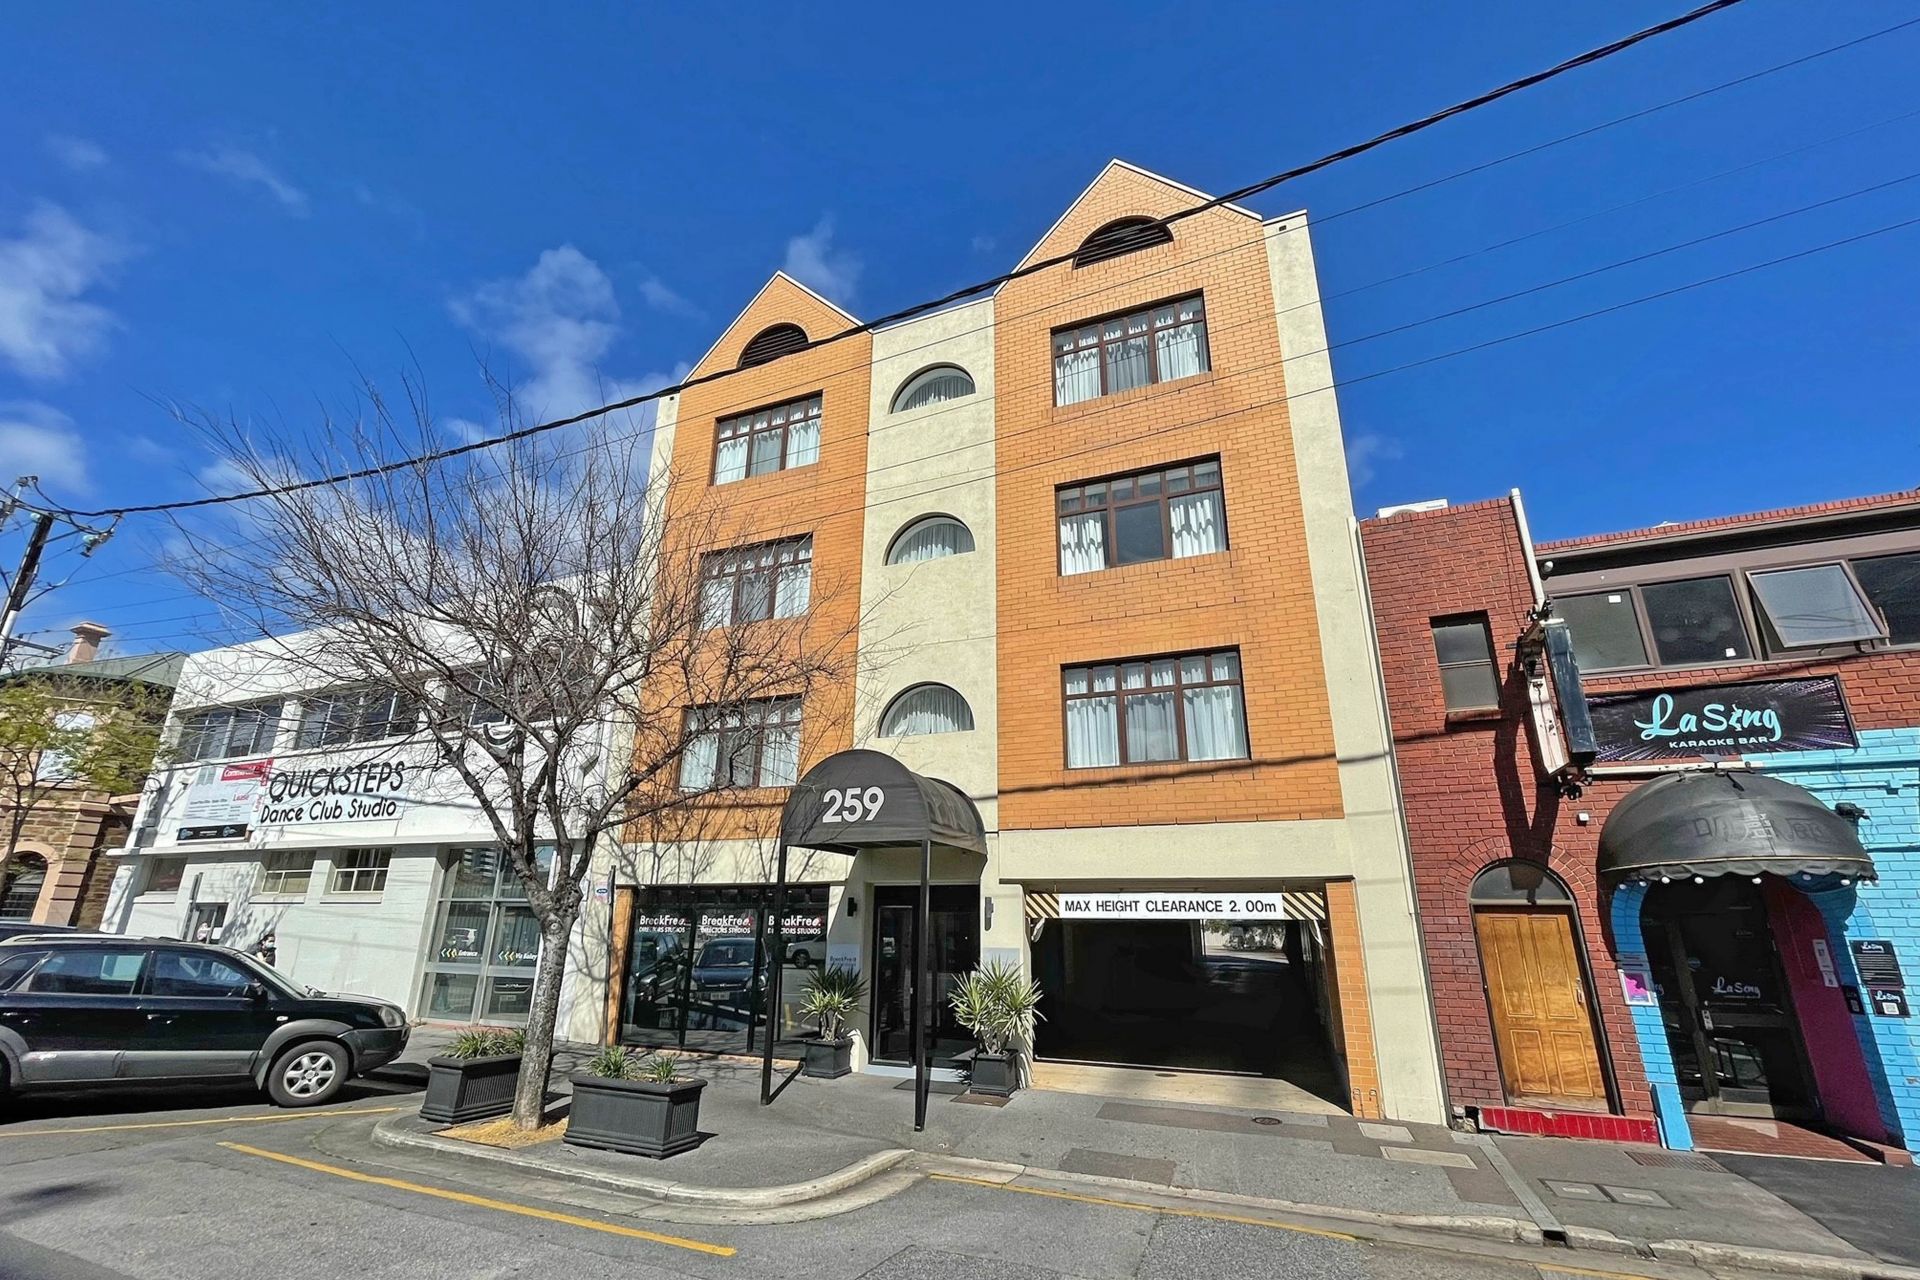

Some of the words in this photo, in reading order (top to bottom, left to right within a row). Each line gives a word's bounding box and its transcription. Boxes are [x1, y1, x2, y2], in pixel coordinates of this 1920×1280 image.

[1633, 693, 1698, 741] La
[1669, 738, 1735, 748] KARAOKE
[1738, 736, 1768, 745] BAR
[268, 760, 405, 803] QUICKSTEPS
[260, 804, 303, 824] Dance
[309, 799, 343, 821] Club
[347, 797, 397, 819] Studio
[823, 786, 885, 823] 259
[1064, 900, 1092, 912] MAX
[1096, 900, 1140, 912] HEIGHT
[1145, 900, 1224, 913] CLEARANCE
